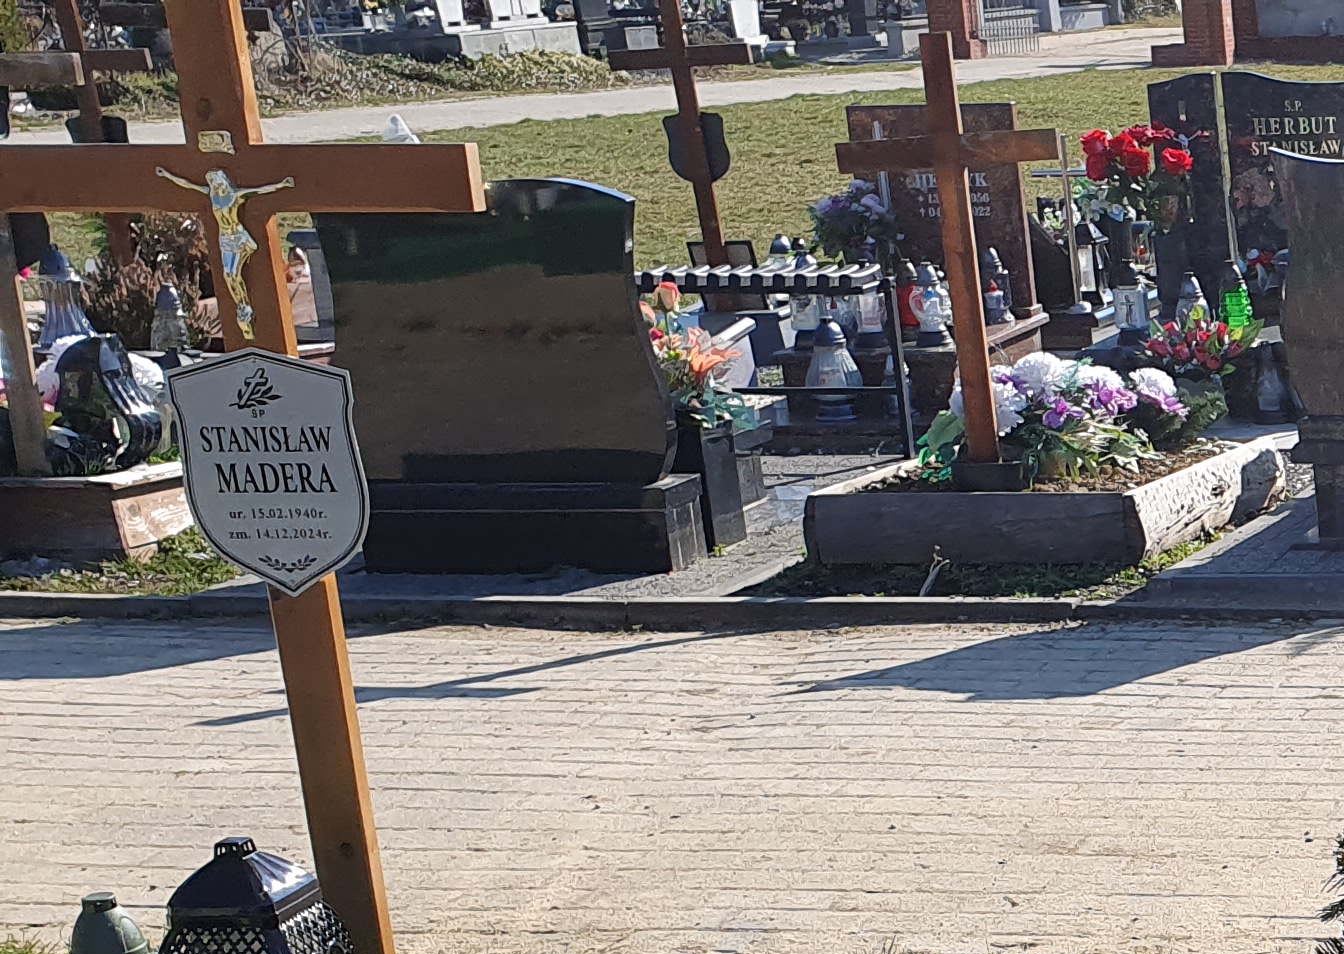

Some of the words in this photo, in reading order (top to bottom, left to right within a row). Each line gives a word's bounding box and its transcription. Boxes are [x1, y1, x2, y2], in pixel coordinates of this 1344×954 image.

[1253, 116, 1337, 136] HERBUT
[199, 426, 331, 453] STANISŁAW
[215, 462, 338, 494] MADERA
[228, 510, 246, 520] ur.
[251, 508, 327, 520] 15.02.1940r.
[229, 530, 250, 540] zm.
[256, 528, 332, 540] 14.12.2024r.
